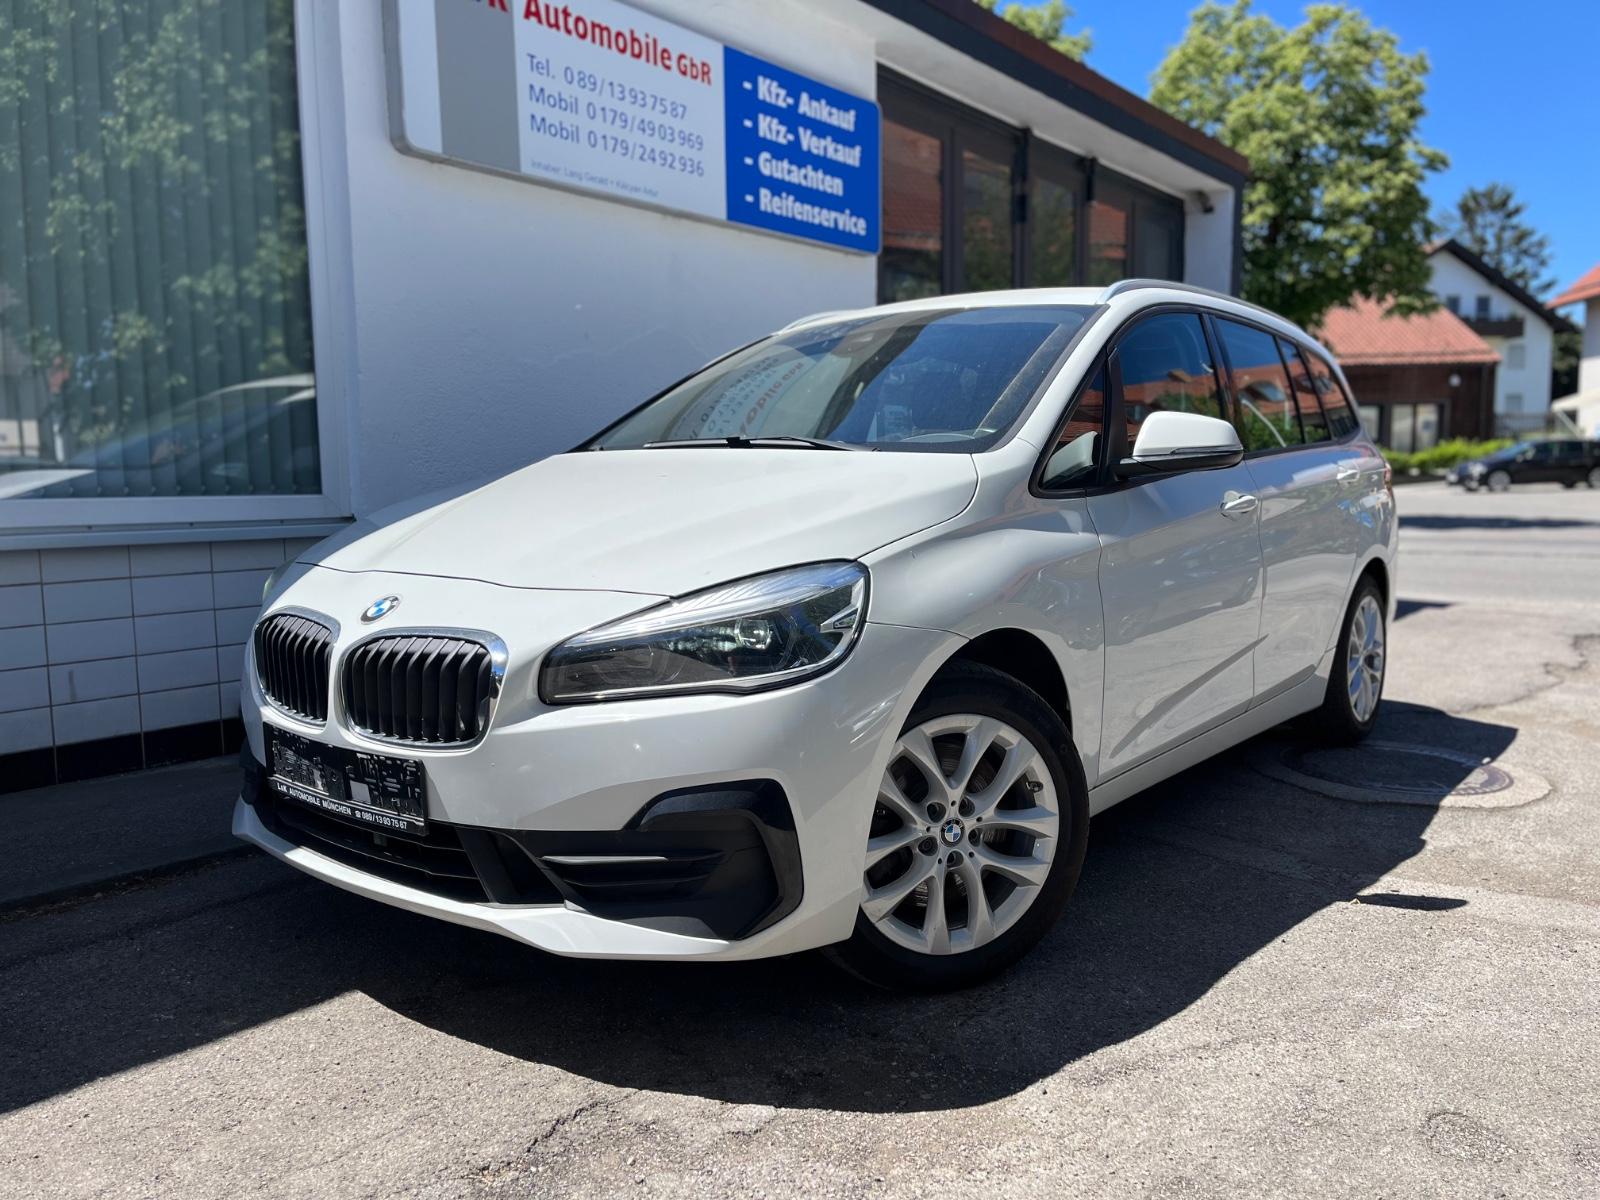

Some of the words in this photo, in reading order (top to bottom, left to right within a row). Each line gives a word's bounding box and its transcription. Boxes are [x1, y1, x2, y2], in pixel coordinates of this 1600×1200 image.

[523, 0, 673, 71] Automobile
[676, 53, 712, 86] GbR
[527, 53, 556, 80] Tel.
[528, 83, 579, 116] Mobil
[757, 75, 795, 109] Kfz-
[798, 91, 857, 132] Ankauf
[530, 113, 580, 145] Mobil
[757, 113, 795, 146] Kfz-
[798, 126, 862, 168] Verkauf
[757, 151, 844, 197] Gutachten
[758, 187, 867, 236] Reifenservice
[322, 799, 352, 815] MÜNCHEN
